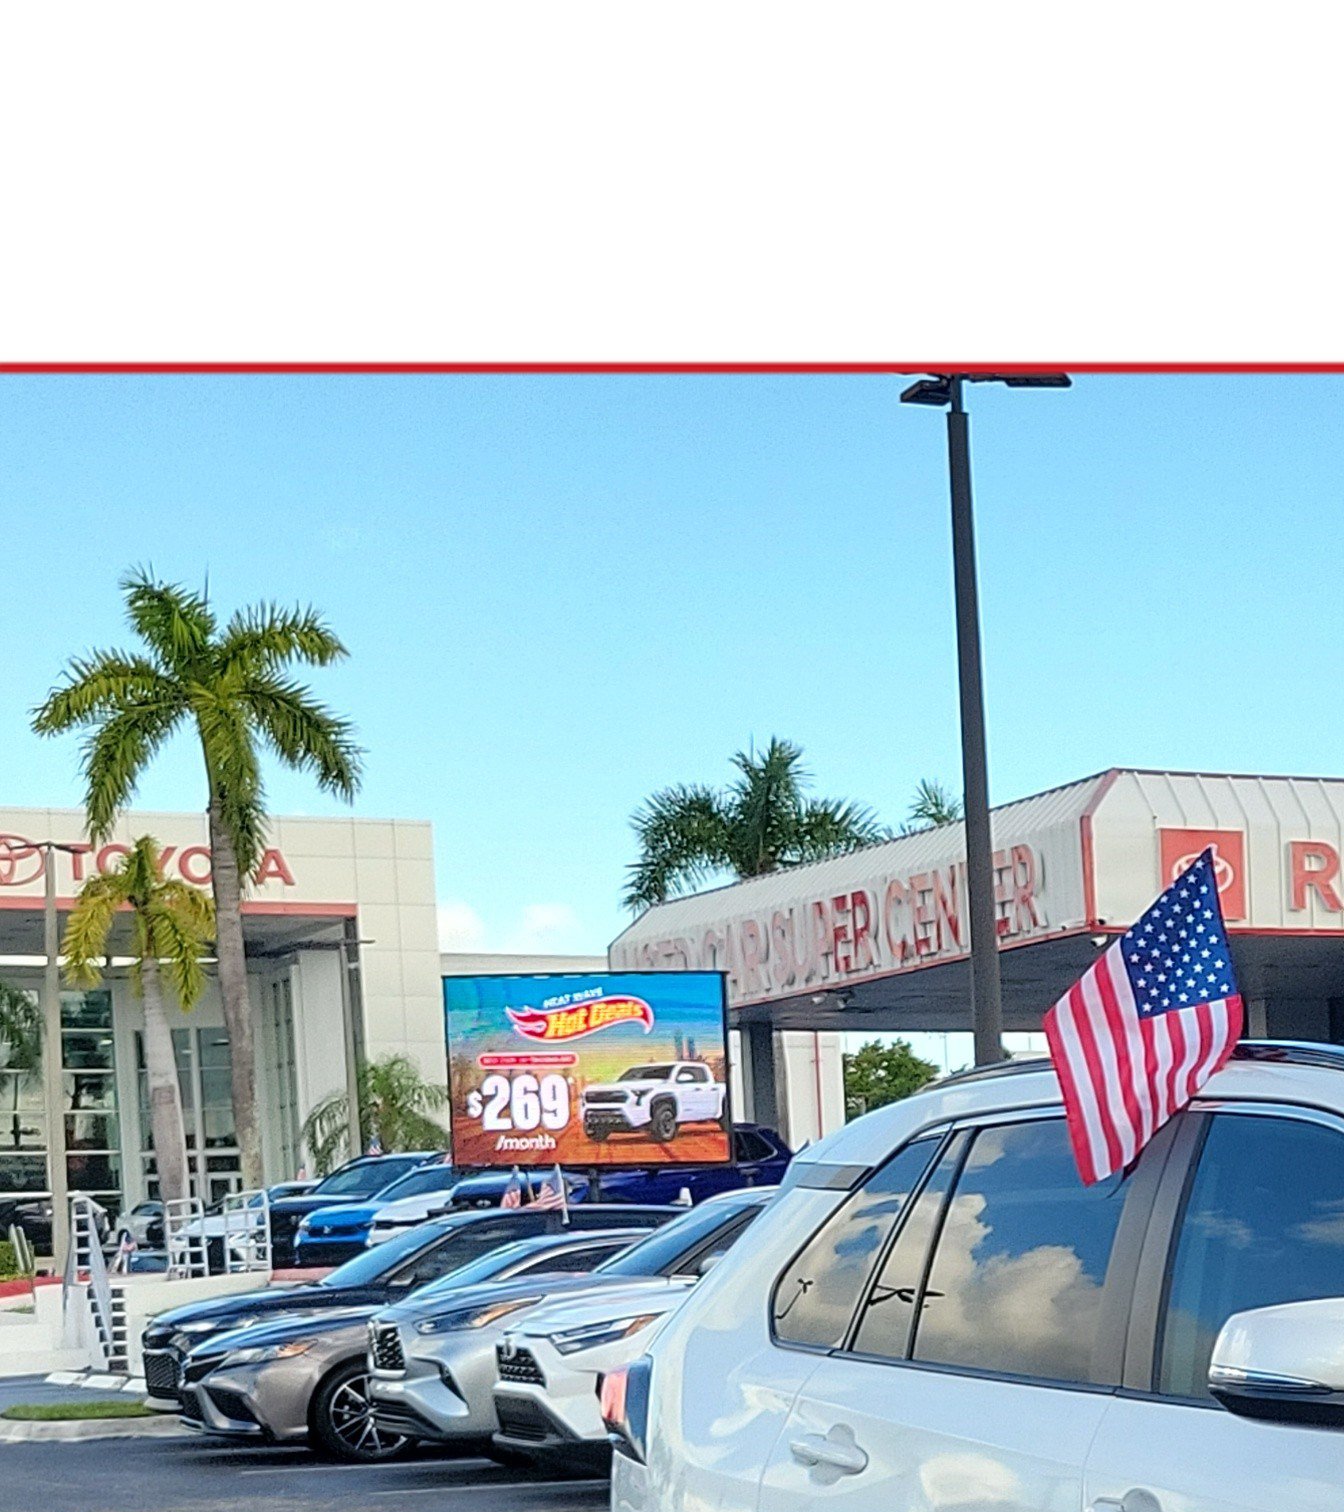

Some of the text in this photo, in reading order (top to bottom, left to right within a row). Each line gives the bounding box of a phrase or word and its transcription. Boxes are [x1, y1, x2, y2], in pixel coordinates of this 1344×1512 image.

[772, 889, 881, 987] SUPER
[885, 843, 1048, 956] CENER
[545, 1001, 645, 1038] Hot Deals
[496, 1134, 557, 1151] /month
